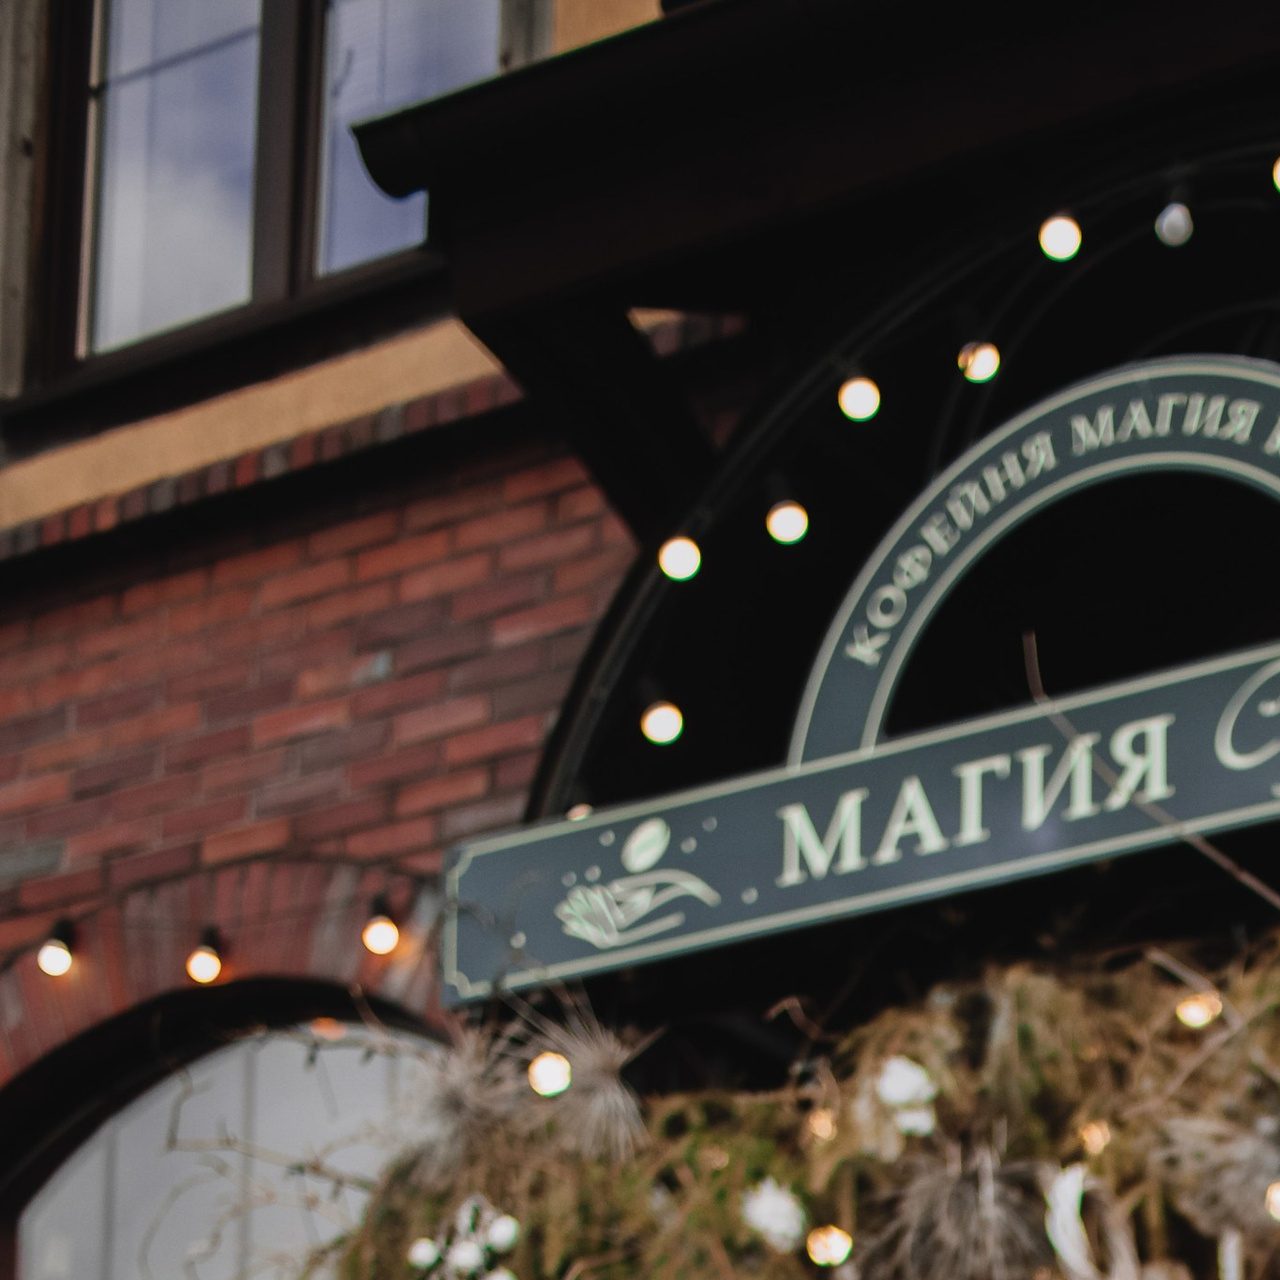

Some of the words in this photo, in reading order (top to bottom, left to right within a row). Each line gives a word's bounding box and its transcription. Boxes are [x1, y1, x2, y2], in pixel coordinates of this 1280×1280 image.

[845, 431, 1057, 666] КОФЕЙНЯ
[1071, 392, 1261, 456] МАГИЯ
[776, 713, 1175, 887] МАГИЯ
